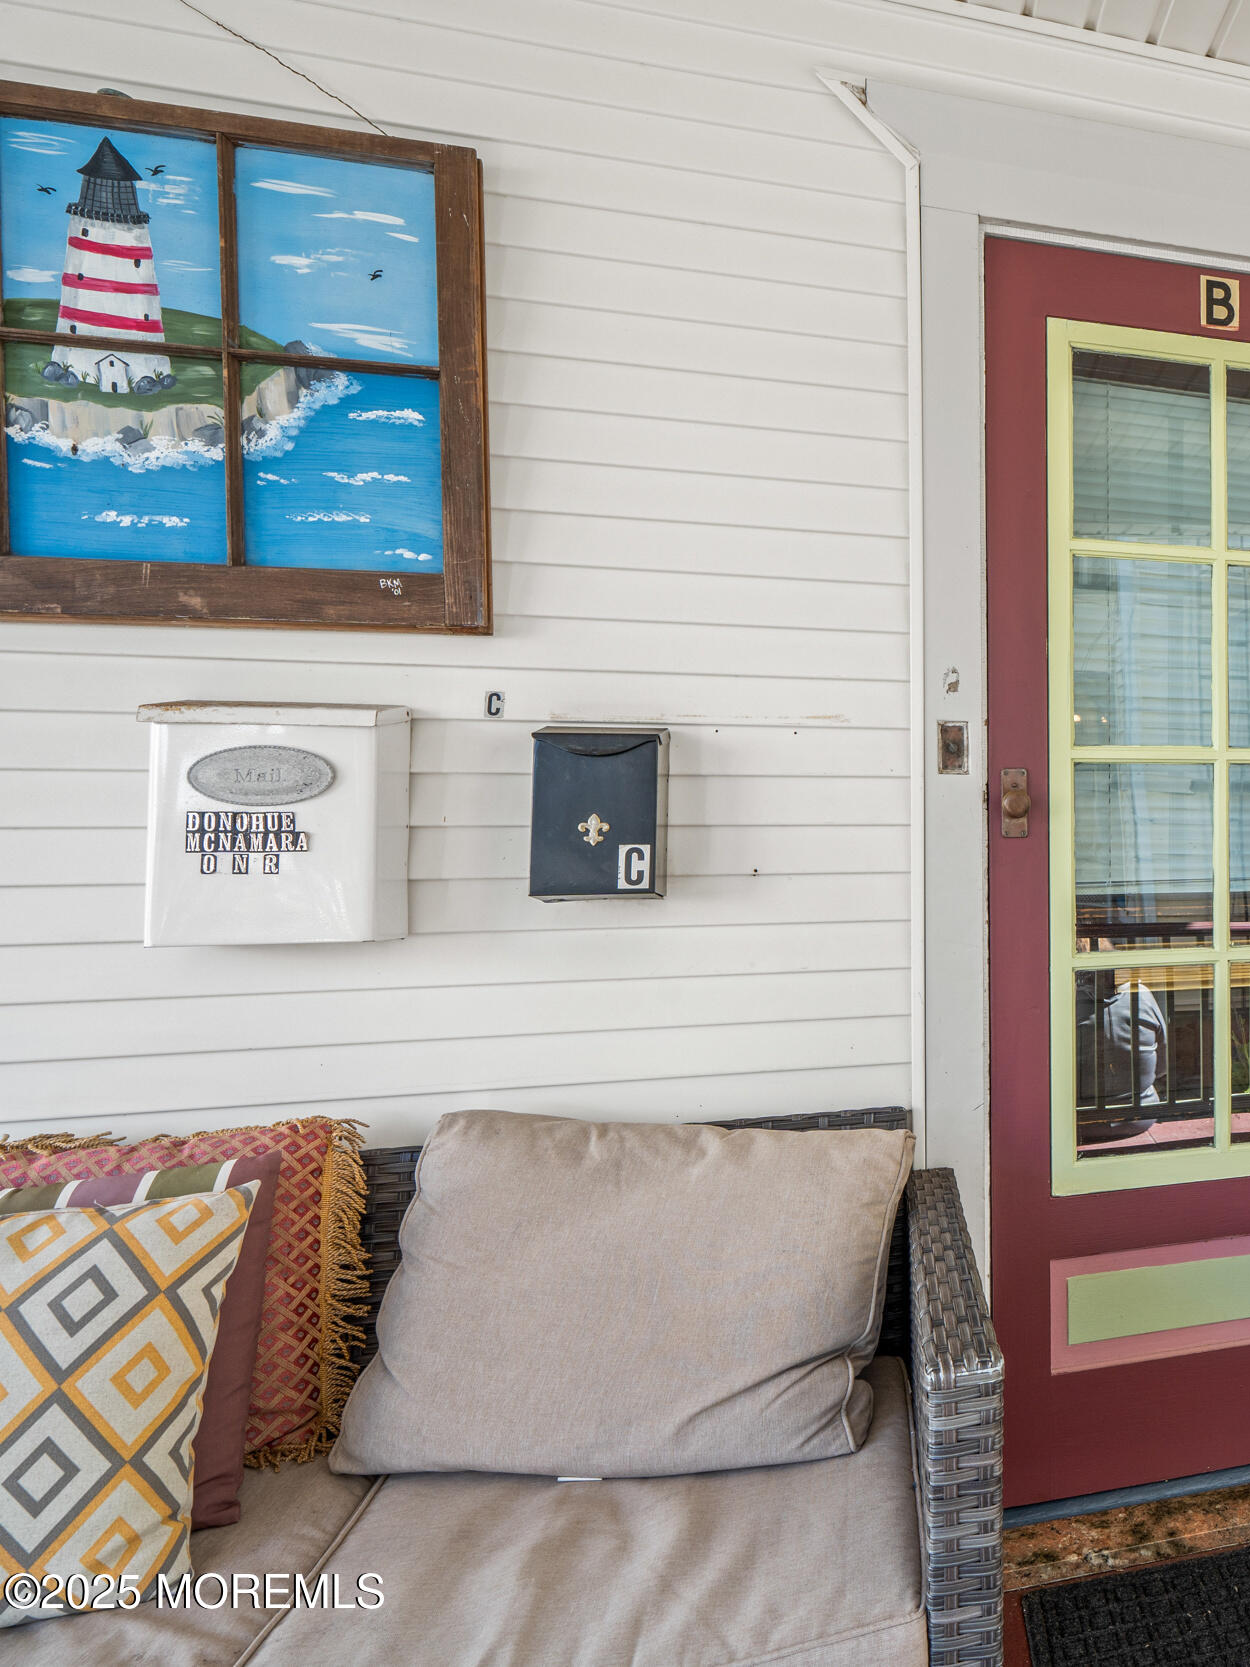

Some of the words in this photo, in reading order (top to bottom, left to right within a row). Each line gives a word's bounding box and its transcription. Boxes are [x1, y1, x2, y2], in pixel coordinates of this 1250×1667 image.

[1206, 280, 1235, 326] B
[487, 692, 501, 716] C
[234, 768, 281, 782] Mail
[186, 812, 295, 832] DONOHUE
[186, 832, 309, 852] MCNAMARA
[624, 846, 645, 887] C
